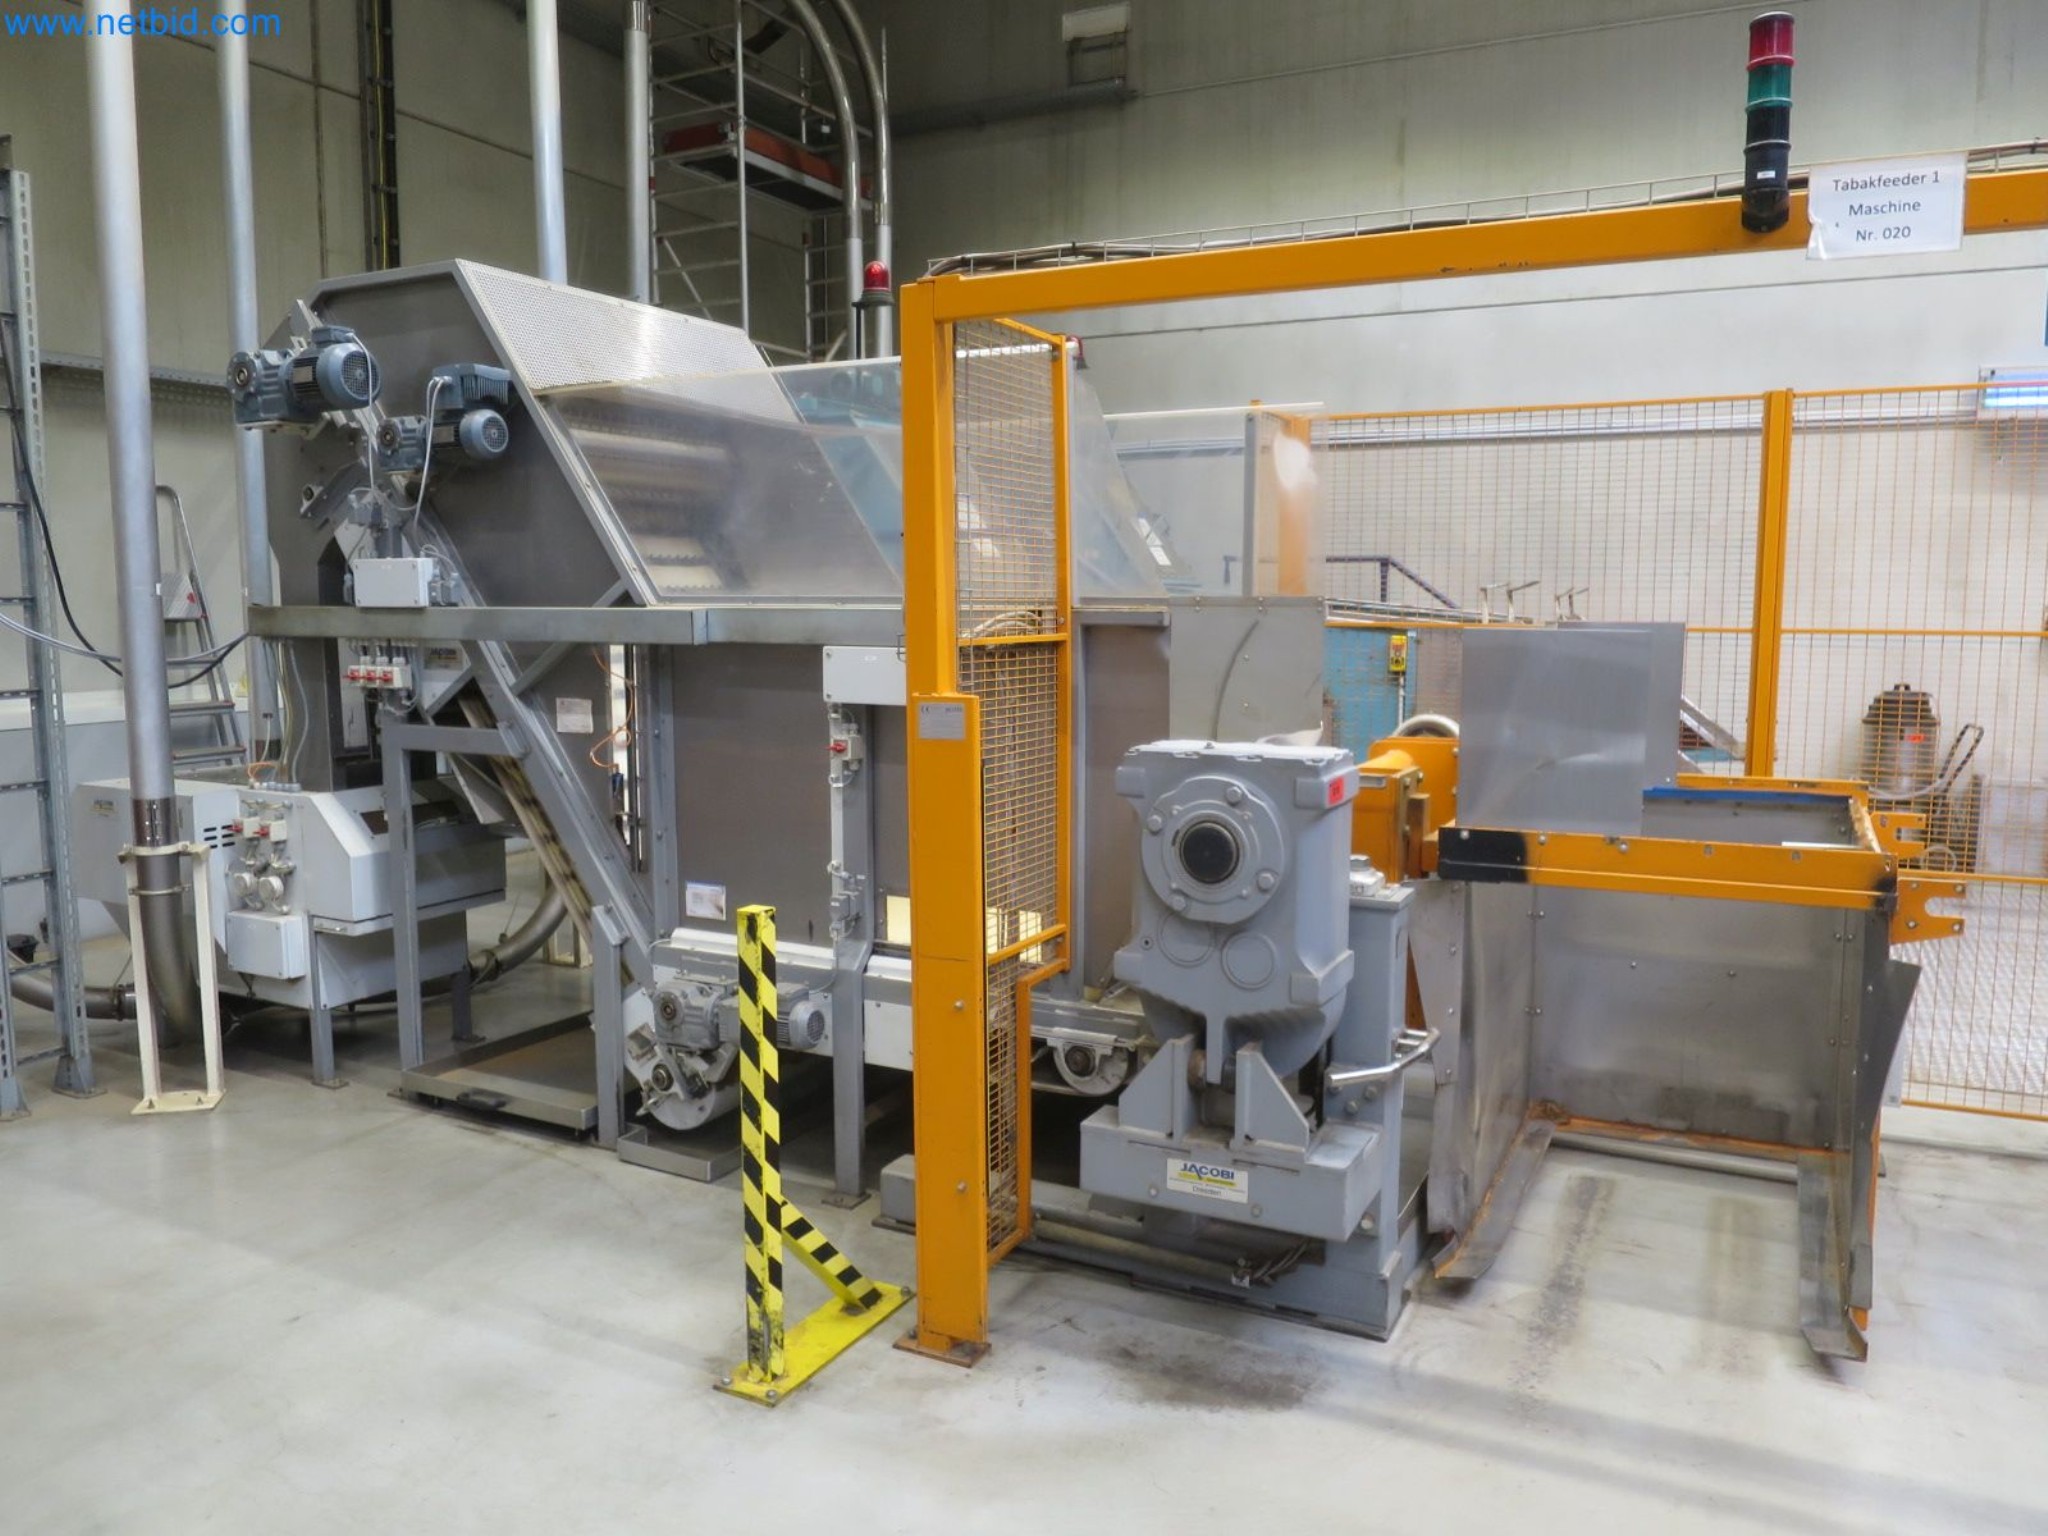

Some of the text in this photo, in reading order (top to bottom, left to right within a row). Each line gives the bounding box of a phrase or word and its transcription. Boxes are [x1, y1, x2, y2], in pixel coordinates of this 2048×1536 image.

[1832, 171, 1940, 191] Tabakfeeder 1
[1848, 200, 1921, 216] Maschine
[1855, 225, 1911, 242] Nr. 020
[1181, 1163, 1234, 1179] JACOBI
